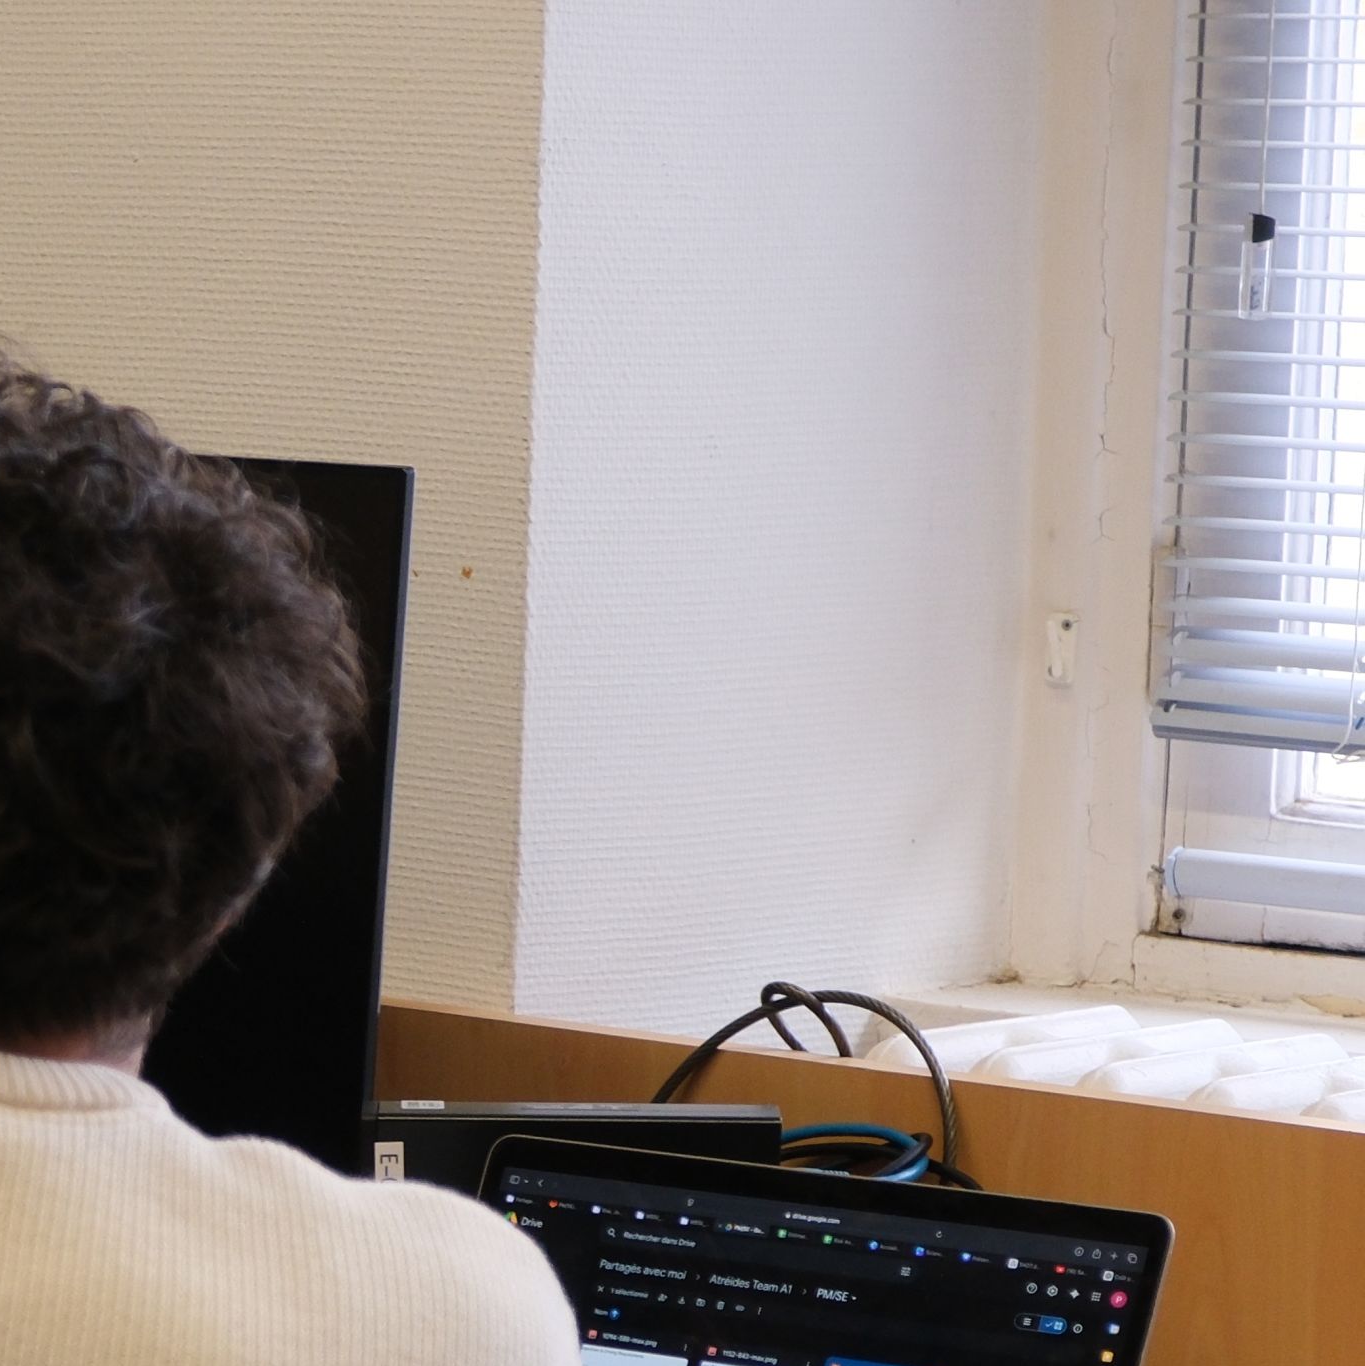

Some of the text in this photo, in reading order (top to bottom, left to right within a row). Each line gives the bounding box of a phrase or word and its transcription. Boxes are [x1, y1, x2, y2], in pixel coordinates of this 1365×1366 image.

[379, 1153, 399, 1183] E-
[520, 1216, 544, 1229] Drive
[623, 1231, 696, 1248] Rechercher dans Drive
[599, 1258, 641, 1277] Partagés
[643, 1266, 666, 1278] avec
[667, 1269, 688, 1280] moi
[752, 1276, 778, 1293] Team
[779, 1282, 793, 1295] A1
[816, 1288, 848, 1303] PM/SE
